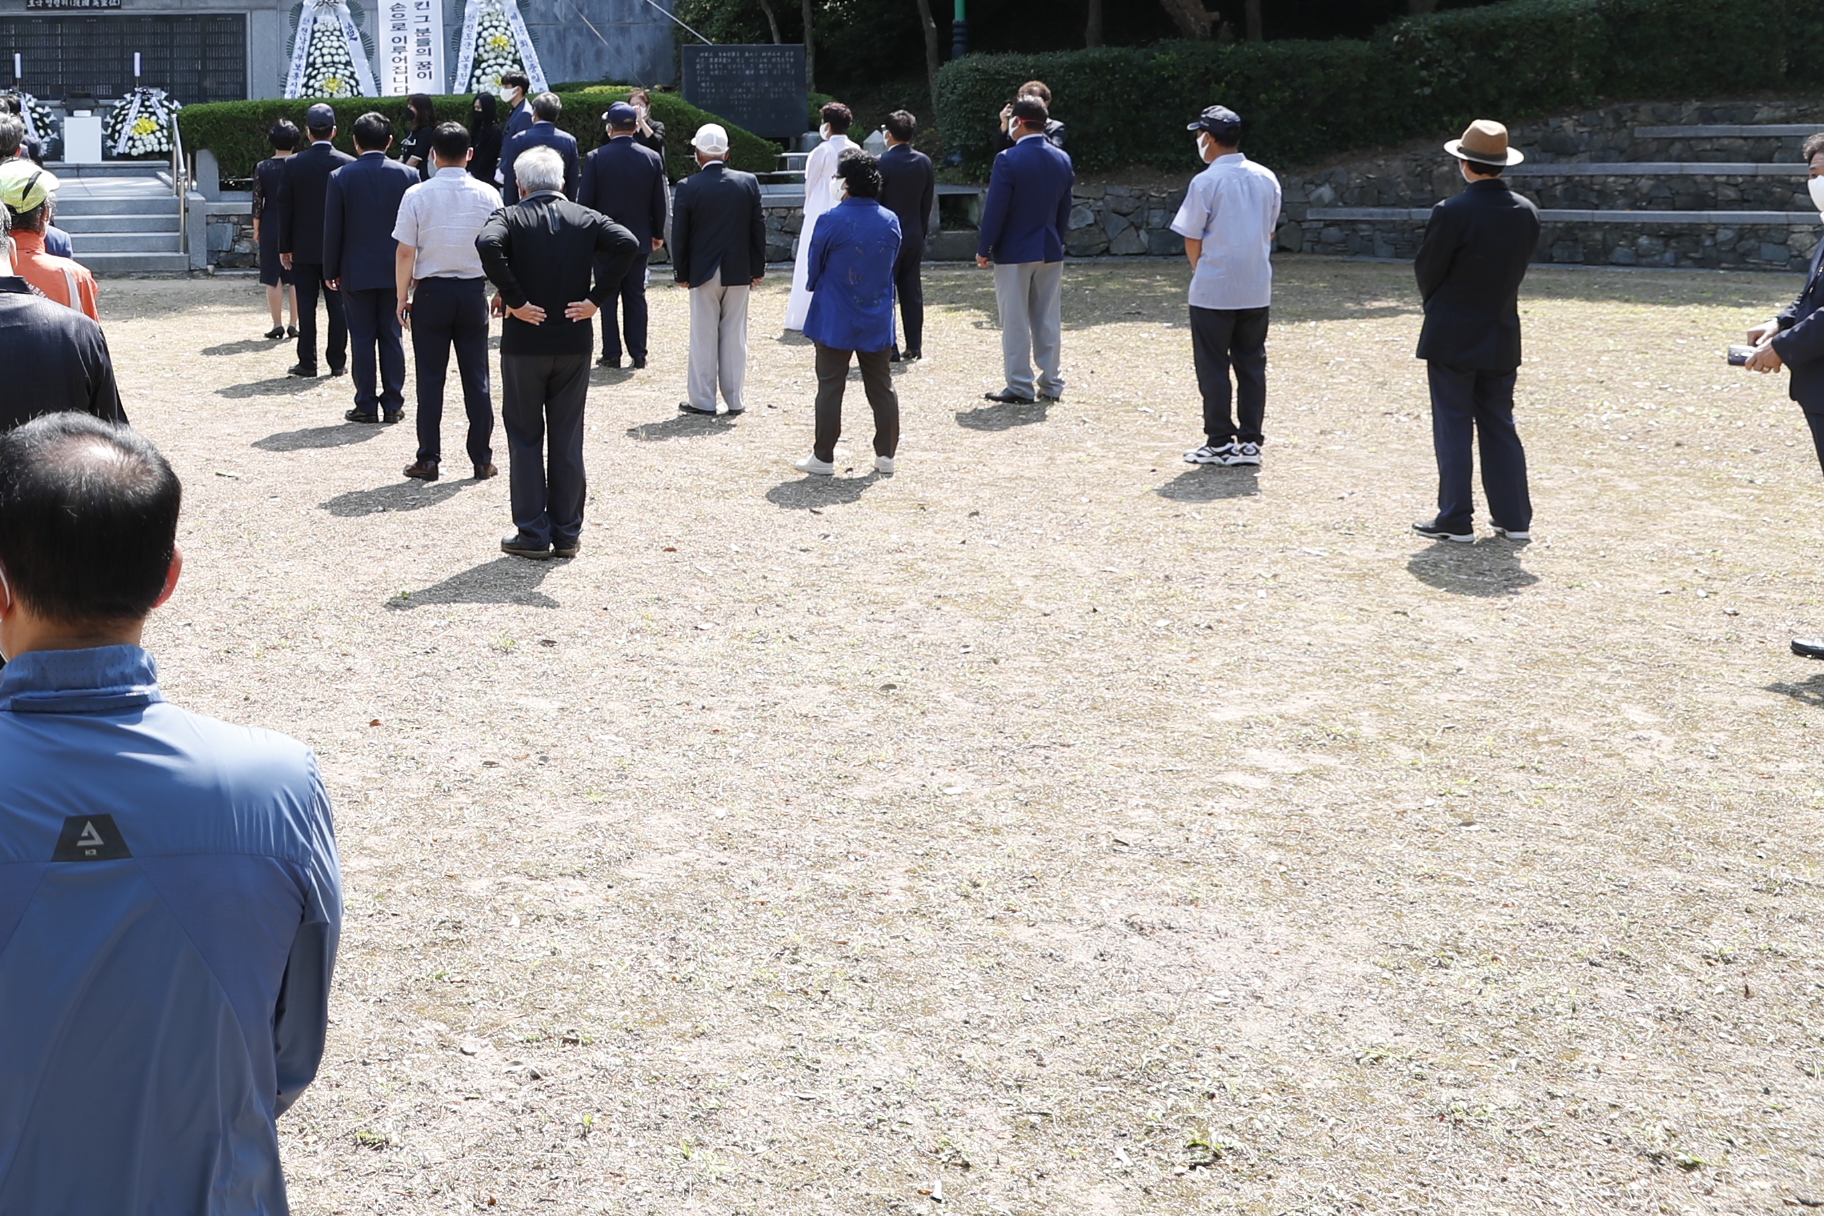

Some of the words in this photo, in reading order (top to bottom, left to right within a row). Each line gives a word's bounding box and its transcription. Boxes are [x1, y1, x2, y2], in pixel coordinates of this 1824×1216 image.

[389, 2, 408, 32] 손으로
[413, 15, 432, 23] 그
[414, 27, 432, 57] 분들의
[390, 35, 411, 95] 이루어집니다
[415, 61, 433, 80] 꿈이
